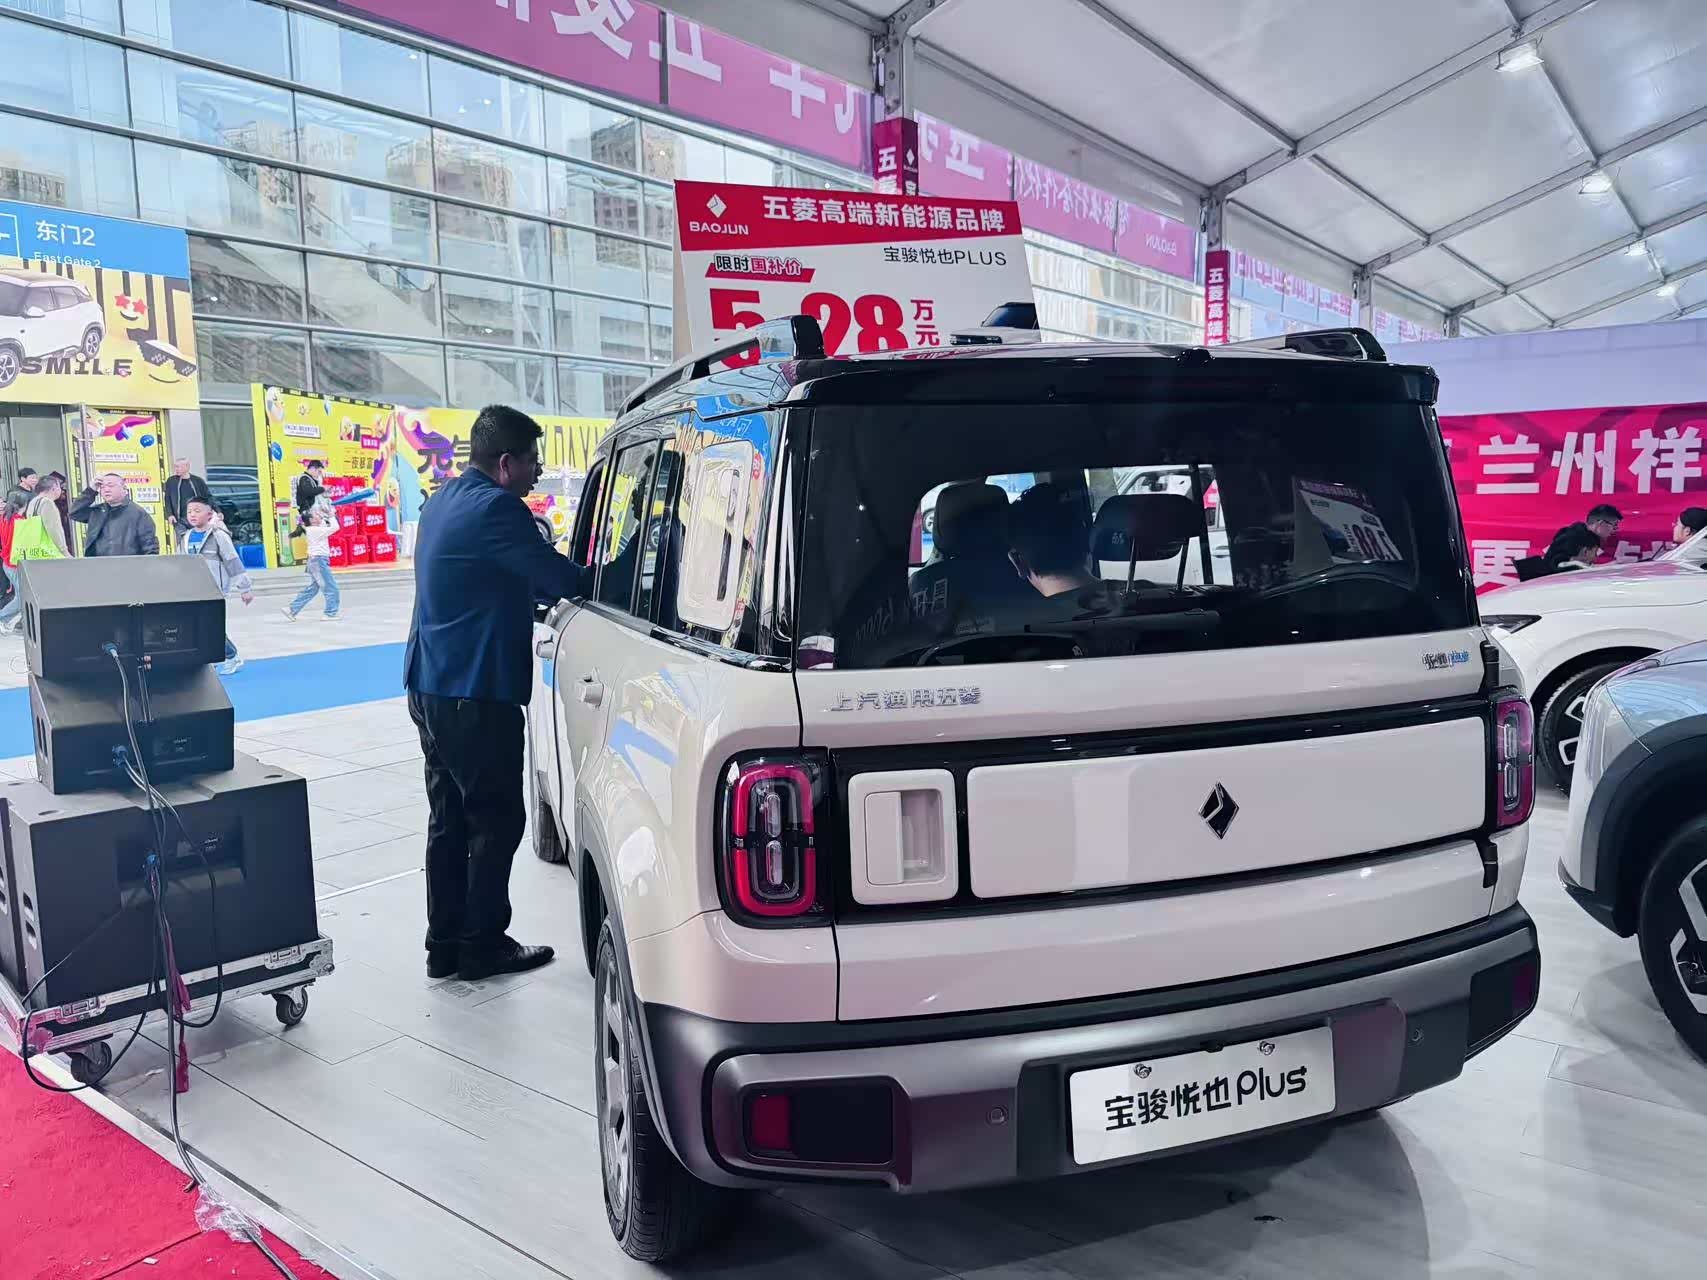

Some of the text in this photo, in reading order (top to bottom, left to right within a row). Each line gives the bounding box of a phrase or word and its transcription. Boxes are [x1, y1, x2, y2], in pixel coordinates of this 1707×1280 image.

[762, 194, 1006, 233] 五菱高端新能源品牌
[35, 219, 96, 247] 东门2
[690, 221, 749, 236] BAOJUN
[715, 253, 804, 277] 限时国补价
[884, 246, 1007, 266] 宝骏悦也PLUS
[910, 299, 941, 346] 万元
[21, 356, 133, 377] SMILE
[1443, 426, 1702, 495] 兰州祥
[830, 687, 982, 712] 上汽通用五菱
